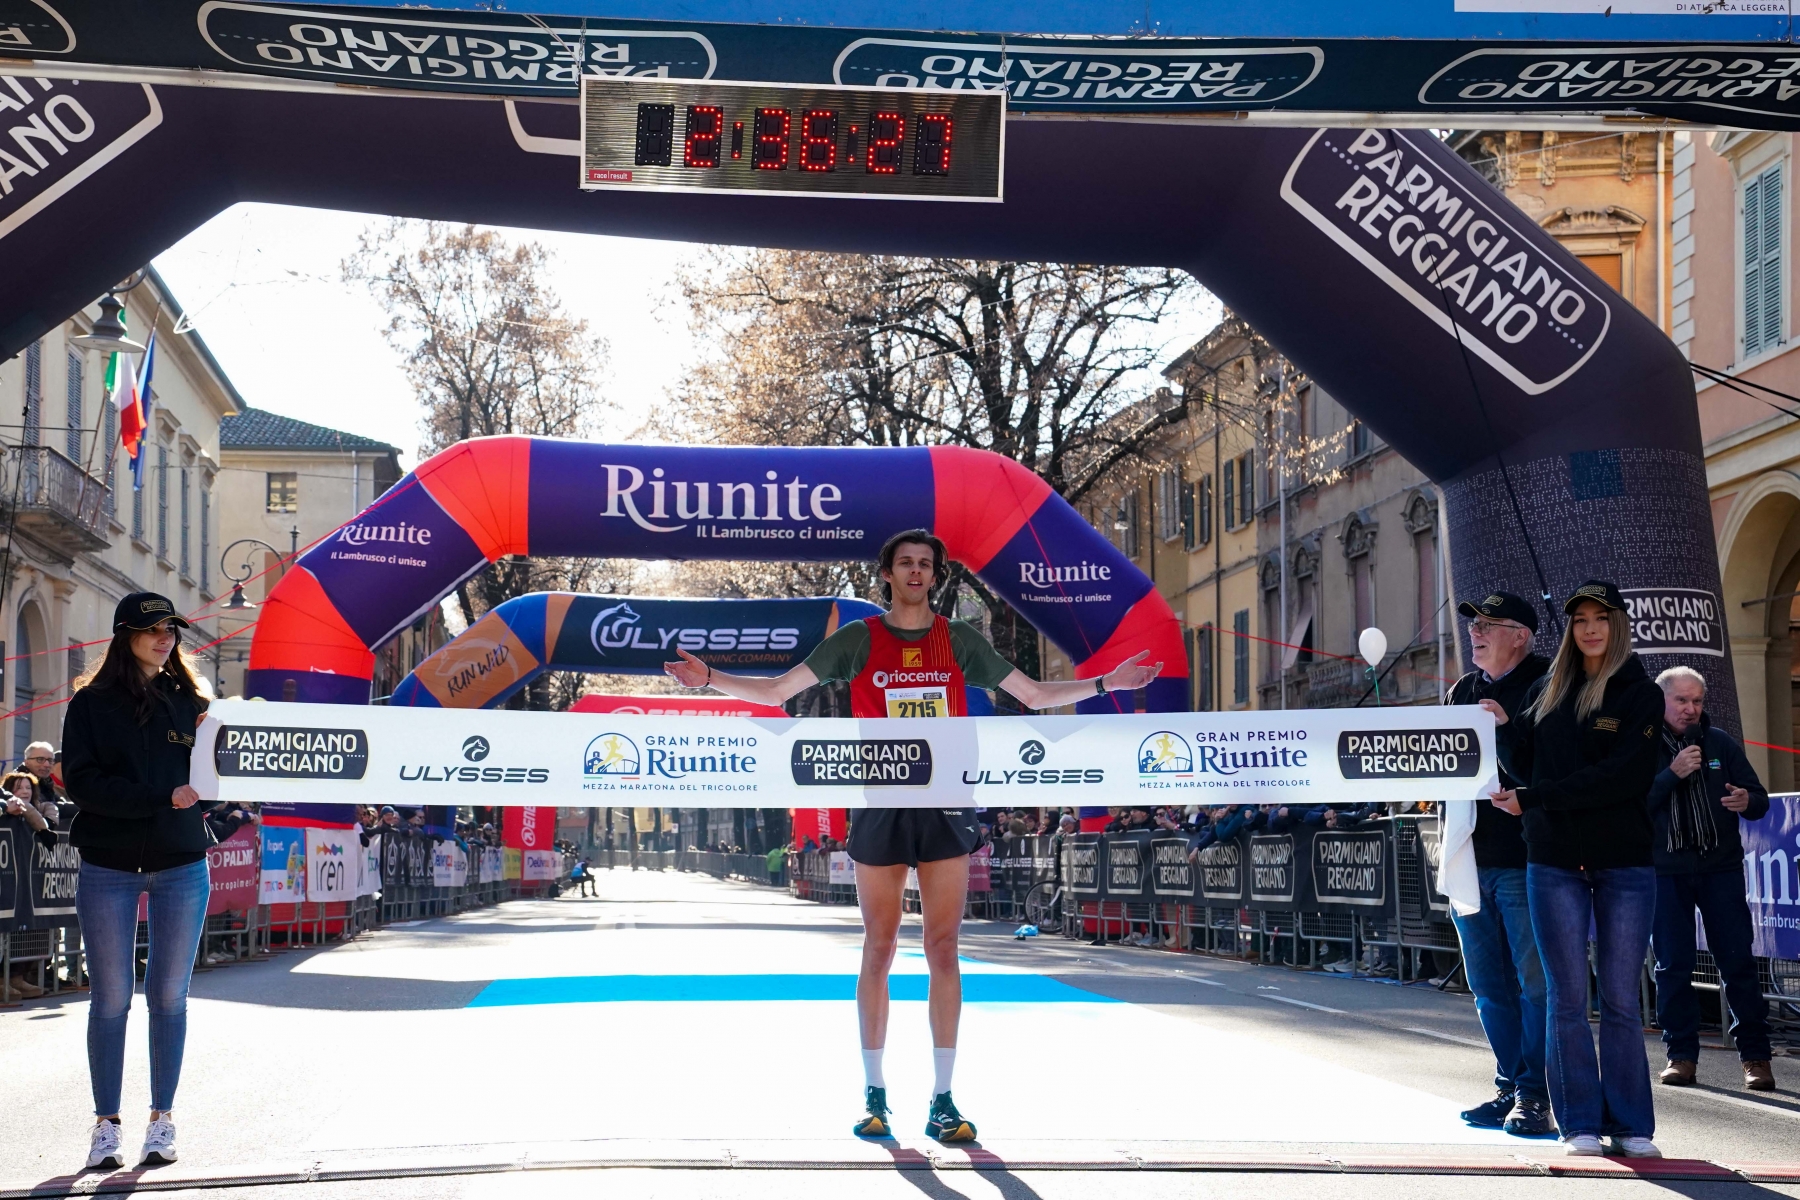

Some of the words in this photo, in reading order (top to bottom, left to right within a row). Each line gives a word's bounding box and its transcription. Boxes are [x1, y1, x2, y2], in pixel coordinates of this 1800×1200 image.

[289, 23, 630, 63] REGGIANO
[921, 55, 1245, 81] REGGIANO
[1518, 58, 1800, 81] EGGIANO
[1458, 79, 1800, 101] ARMIGIANO
[686, 106, 953, 173] 2:36:27
[1347, 129, 1586, 325] PARMIGIANO
[1335, 174, 1538, 344] REGGIANO
[600, 464, 843, 532] Riunite
[336, 521, 432, 546] Riunite
[711, 525, 795, 539] Lambrusco
[799, 526, 812, 539] ci
[816, 527, 864, 540] unisce
[338, 551, 386, 563] Lambrusco
[388, 555, 396, 564] ci
[398, 557, 427, 567] unisce
[1018, 560, 1112, 589] Riunite
[1028, 593, 1073, 603] Lambrusco
[1075, 593, 1083, 603] ci
[1084, 592, 1112, 602] unisce
[1623, 596, 1714, 621] RMIGIANO
[600, 625, 800, 650] ULYSSES
[1630, 620, 1710, 642] EGGIANO
[696, 653, 737, 664] NNING
[738, 653, 793, 664] COMPANY
[447, 663, 476, 697] RUN
[898, 701, 937, 718] 2715
[227, 730, 357, 753] PARMIGIANO
[645, 735, 689, 746] GRAN
[697, 736, 757, 747] PREMIO
[1196, 732, 1240, 742] GRAN
[1247, 730, 1307, 741] PREMIO
[1348, 733, 1469, 753] PARMIGIANO
[239, 752, 344, 773] REGGIANO
[802, 743, 921, 761] PARMIGIANO
[1197, 745, 1308, 775] Riunite
[1361, 753, 1458, 773] REGGIANO
[399, 765, 550, 783] ULYSSES
[646, 748, 757, 779] Riunite
[814, 762, 910, 780] REGGIANO
[583, 783, 616, 791] MEZZA
[702, 784, 758, 792] TRICOLORE
[962, 769, 1105, 785] ULYSSES
[1254, 779, 1311, 787] TRICOLORE
[1320, 841, 1381, 864] PARMIGIANO
[316, 860, 344, 891] iren
